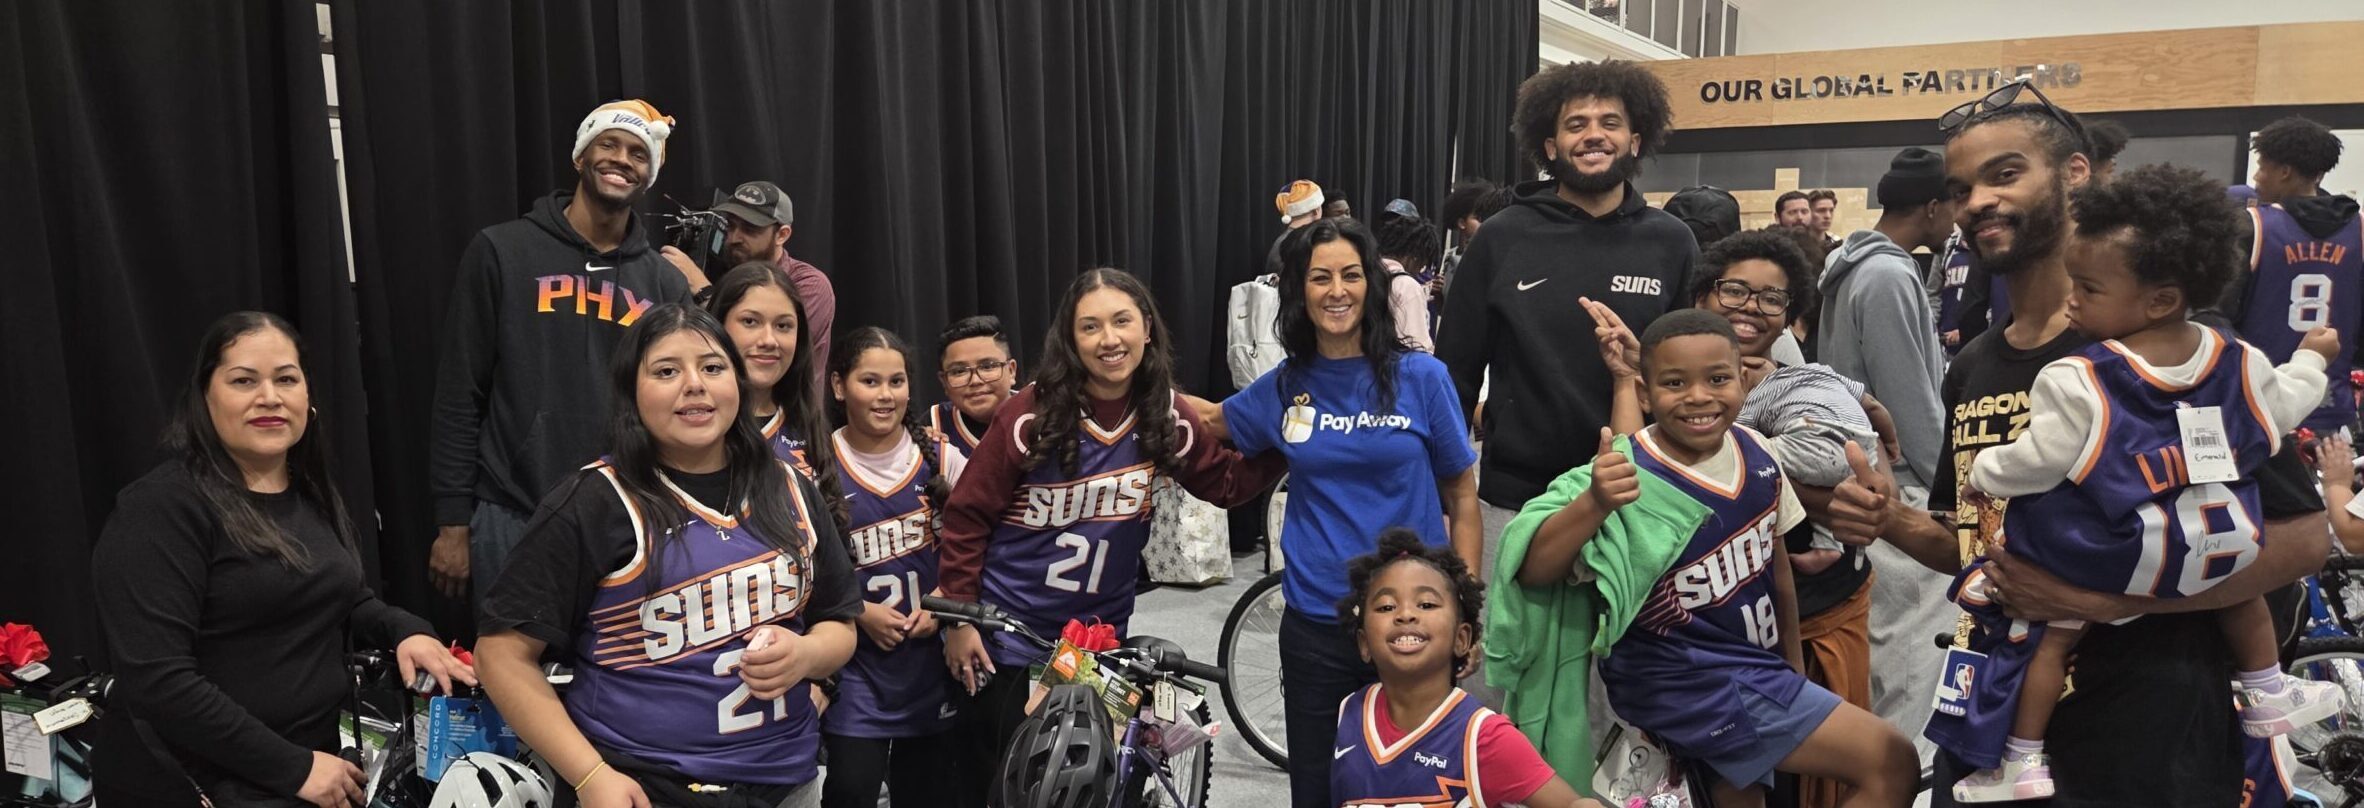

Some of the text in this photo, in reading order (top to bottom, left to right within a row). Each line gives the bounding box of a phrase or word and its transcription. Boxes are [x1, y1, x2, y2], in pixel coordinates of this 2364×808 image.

[1700, 80, 1764, 103] OUR
[1771, 72, 1894, 101] GLOBAL
[2284, 241, 2347, 265] ALLEN
[1610, 275, 1662, 296] SUNS
[2287, 273, 2332, 332] 8
[1320, 411, 1412, 435] Pay Away
[1022, 470, 1150, 528] SUNS
[850, 512, 926, 566] UNS
[1045, 532, 1110, 594] 21
[1674, 511, 1778, 611] SUNS
[2123, 482, 2260, 597] 18
[638, 552, 804, 662] SUNS
[1740, 592, 1779, 650] 18
[432, 703, 442, 760] CONCORD
[1413, 751, 1448, 769] PayPal
